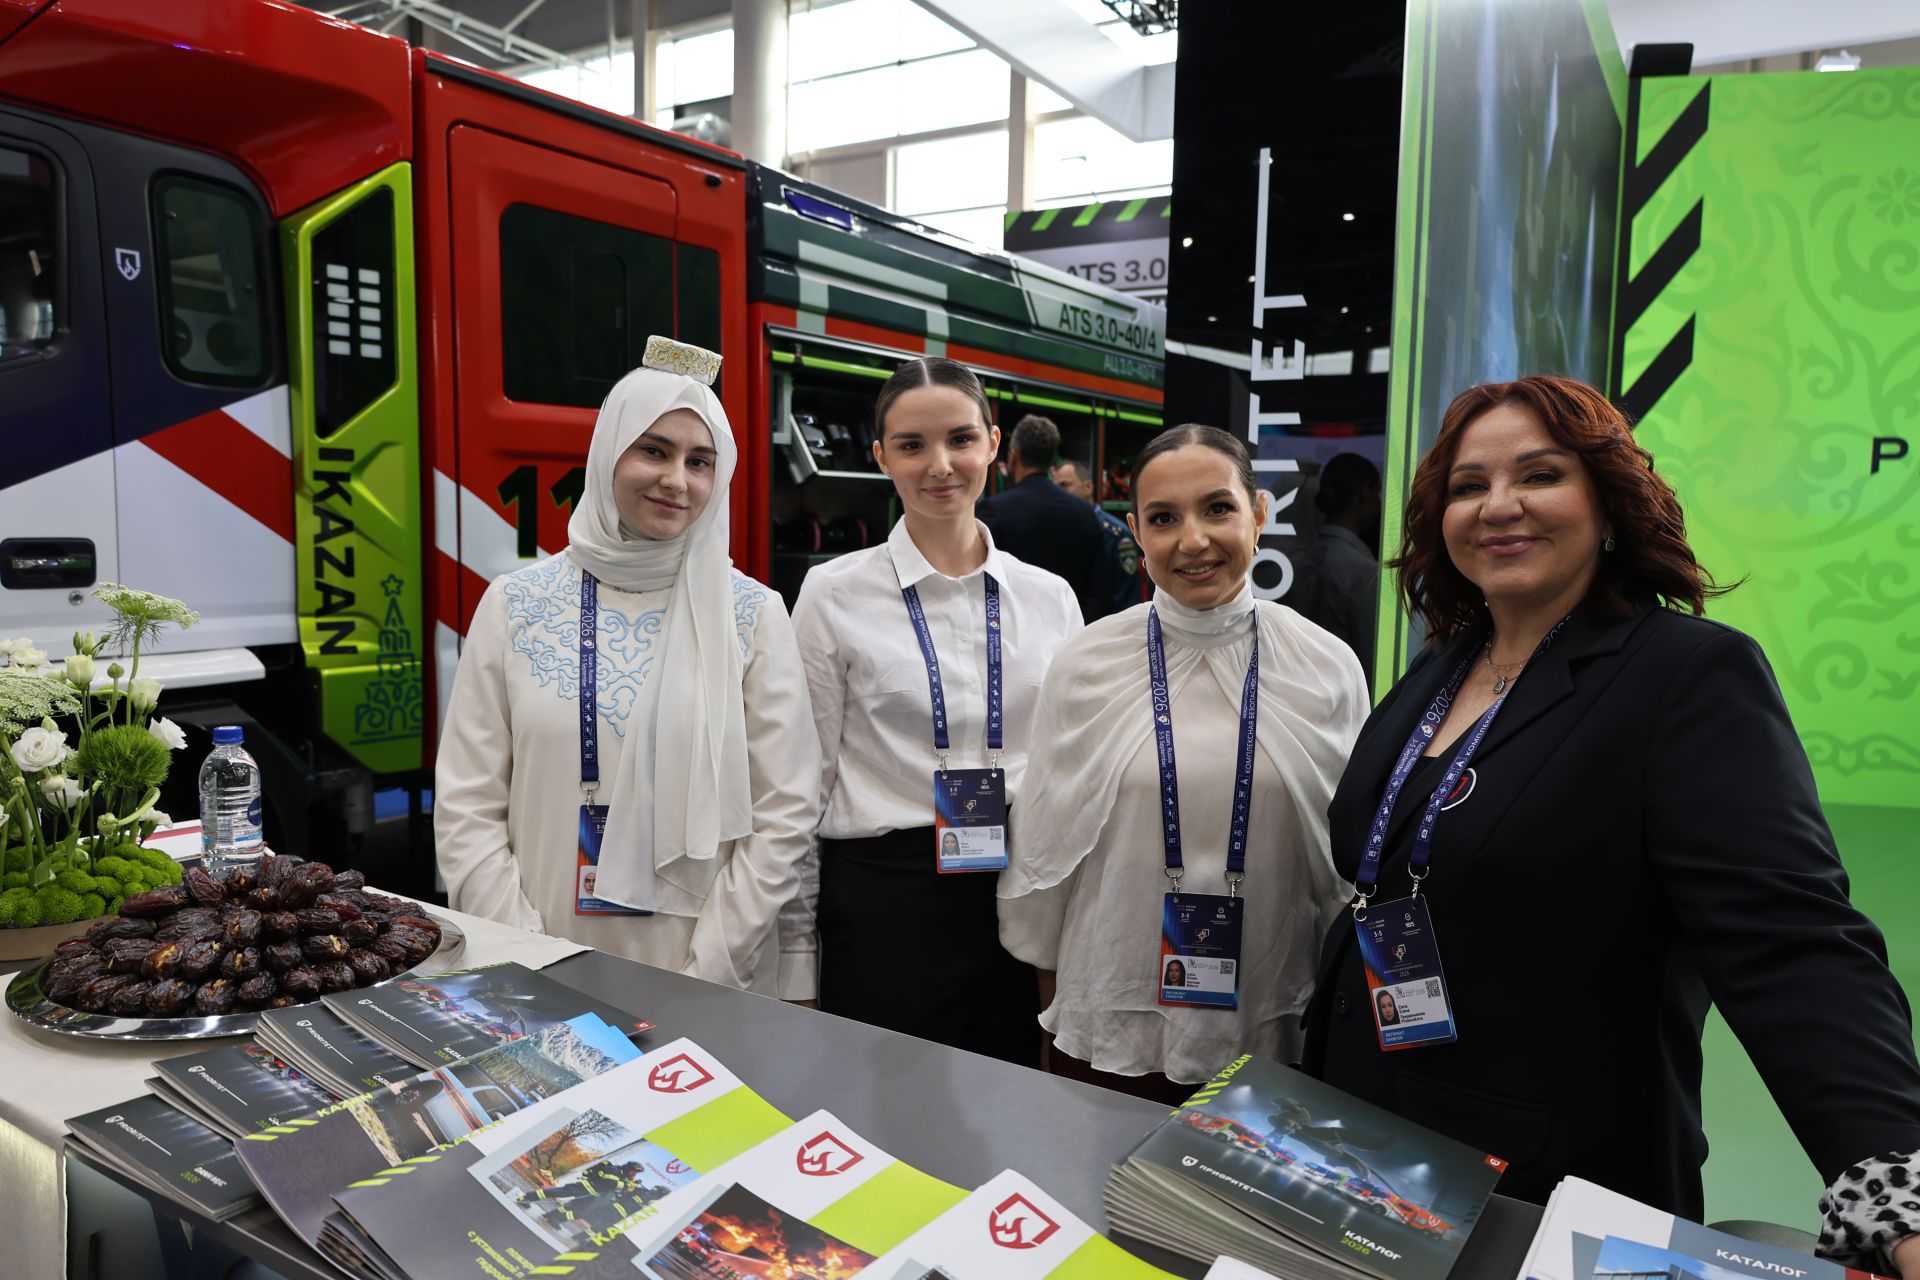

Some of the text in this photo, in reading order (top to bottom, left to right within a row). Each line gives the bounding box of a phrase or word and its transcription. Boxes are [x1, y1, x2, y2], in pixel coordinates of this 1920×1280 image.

[1059, 303, 1157, 352] ATS 3.0-40/4
[986, 592, 999, 618] 2026
[581, 609, 595, 636] 2026
[1149, 618, 1159, 678] INTEGRATED SECURITY
[1152, 680, 1168, 711] 2026
[1426, 688, 1453, 723] 2026
[1158, 740, 1167, 768] September
[1245, 719, 1255, 774] КОМПЛЕКСНАЯ
[591, 1205, 659, 1247] KAZAN
[1340, 1237, 1370, 1256] 2026
[1344, 1230, 1402, 1260] КАТАЛОГ
[1716, 1248, 1808, 1279] КАТАЛОГ
